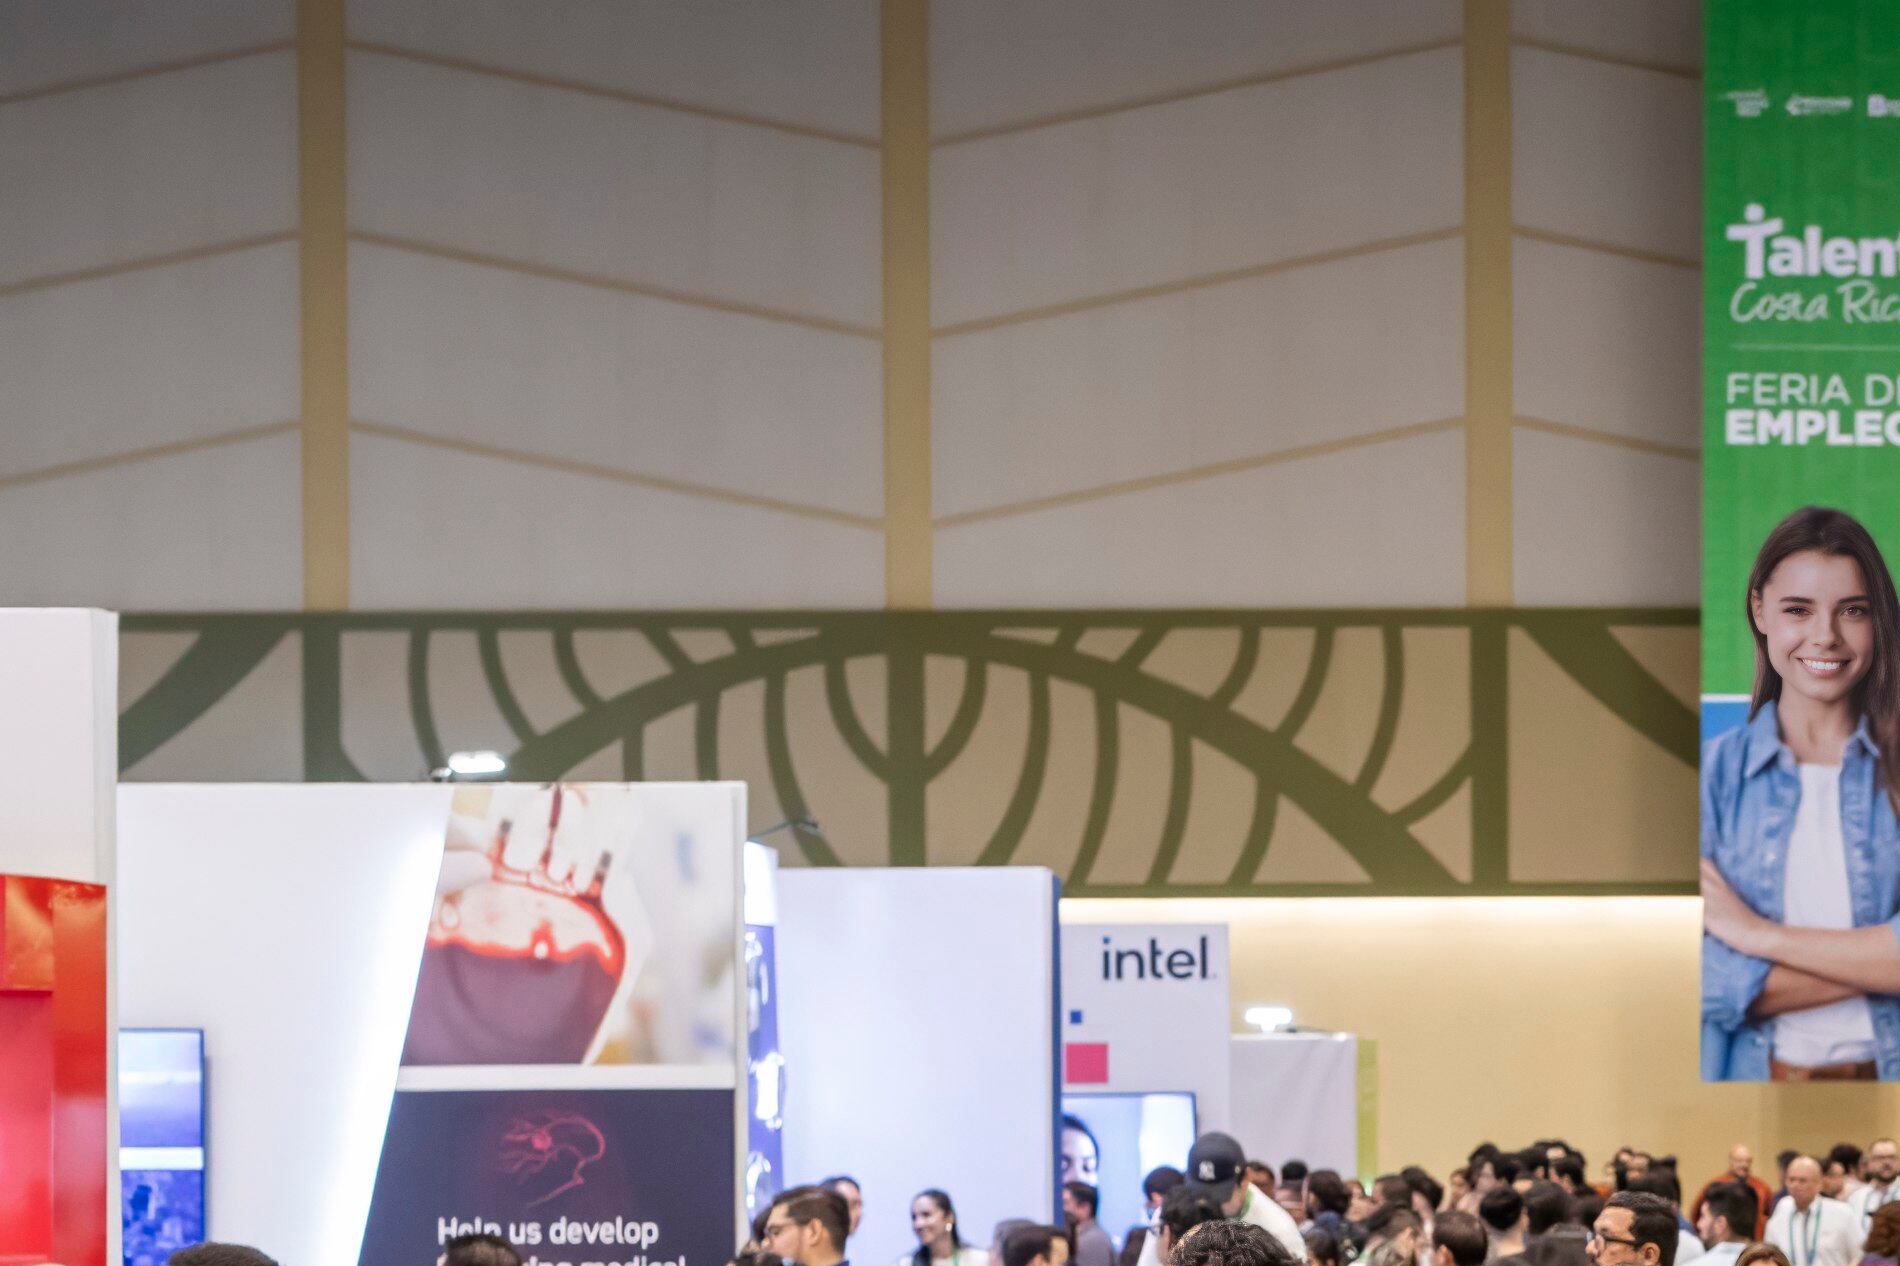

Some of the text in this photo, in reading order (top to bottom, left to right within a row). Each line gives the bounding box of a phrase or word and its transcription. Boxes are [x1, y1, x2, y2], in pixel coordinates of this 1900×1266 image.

[1730, 282, 1830, 324] Costa
[1726, 373, 1852, 407] FERIA
[1102, 934, 1208, 981] intel
[509, 1221, 543, 1245] us
[550, 1215, 660, 1250] develop
